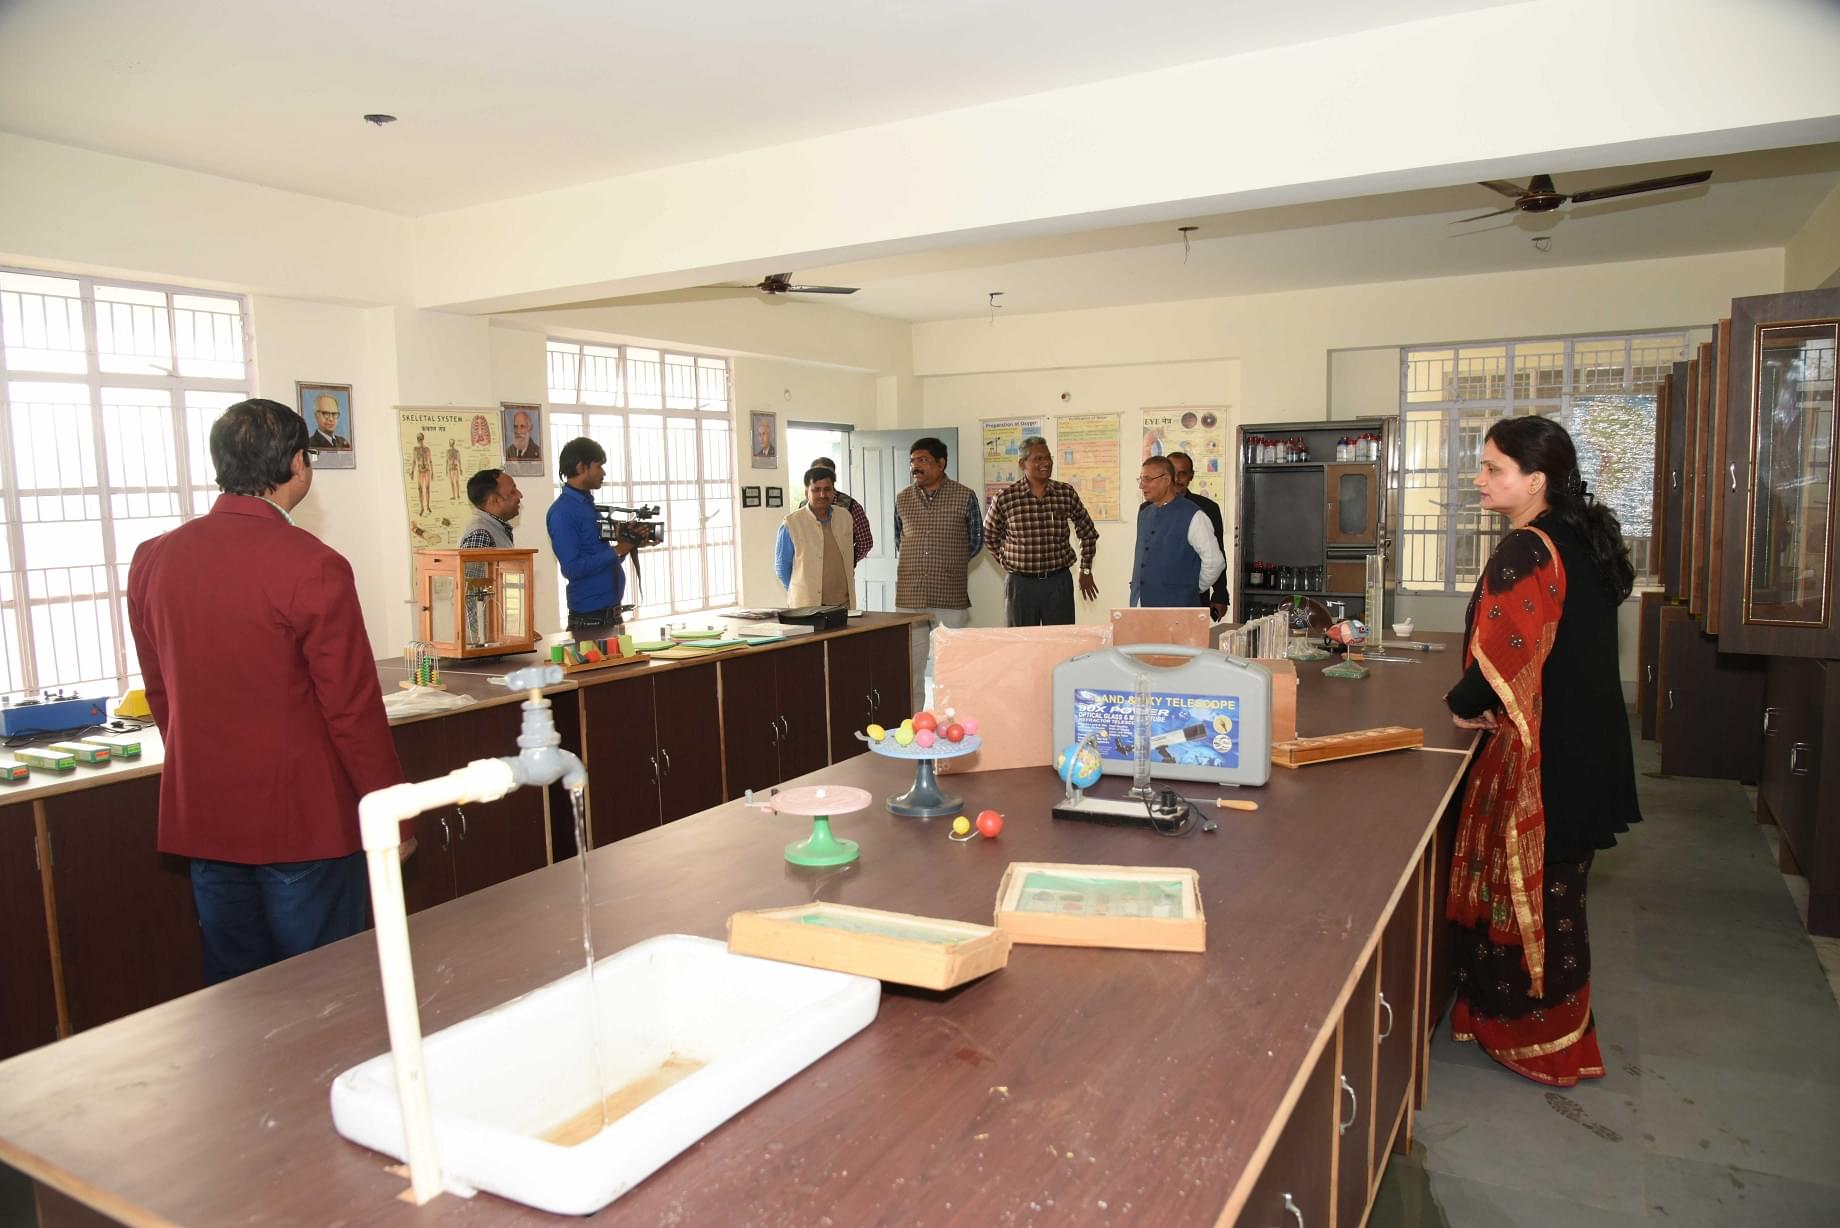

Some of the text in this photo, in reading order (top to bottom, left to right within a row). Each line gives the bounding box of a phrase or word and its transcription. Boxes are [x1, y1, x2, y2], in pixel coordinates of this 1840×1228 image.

[402, 414, 463, 423] SKELETAL SYSTEM
[1165, 697, 1236, 710] TELESCOPE
